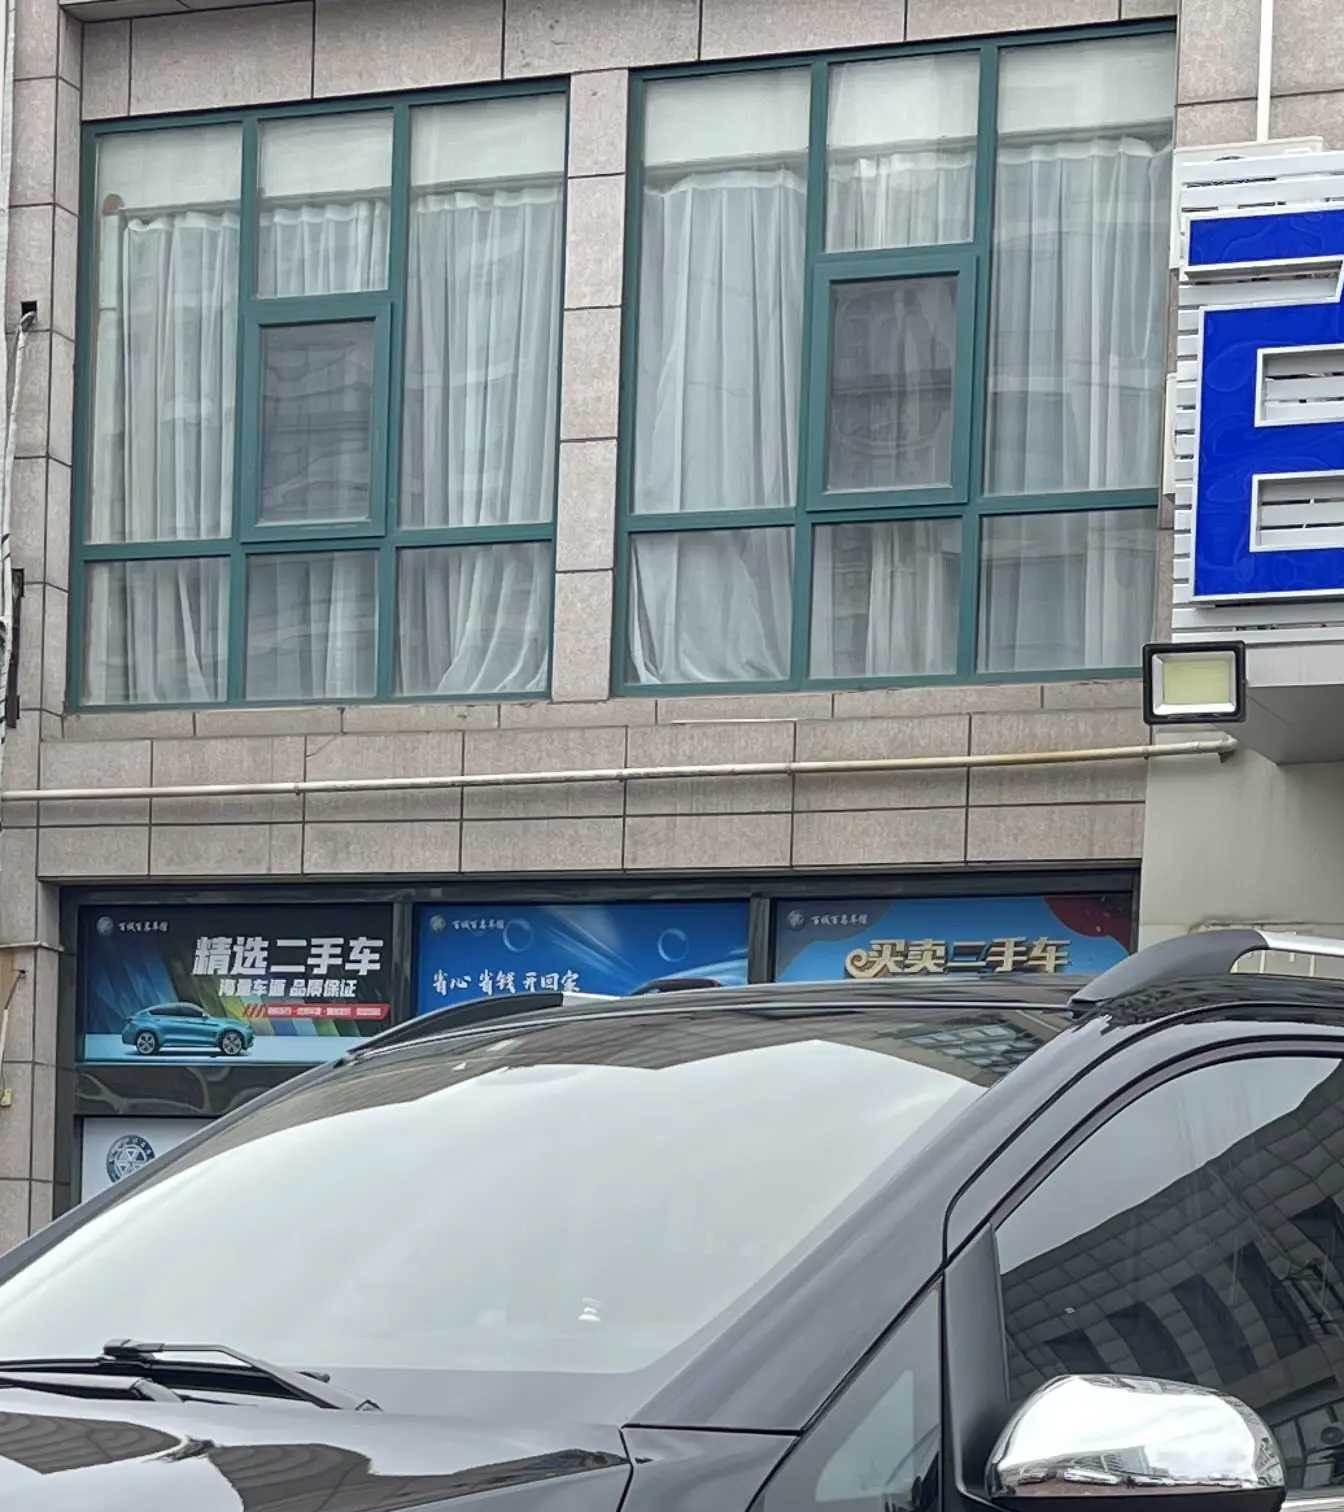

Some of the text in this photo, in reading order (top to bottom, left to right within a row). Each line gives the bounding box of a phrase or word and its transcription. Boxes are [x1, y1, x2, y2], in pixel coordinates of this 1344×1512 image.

[191, 936, 385, 976] 精选二手车
[846, 936, 1072, 978] 买卖二手车
[289, 978, 358, 998] 品质保证
[522, 969, 581, 993] 开回家
